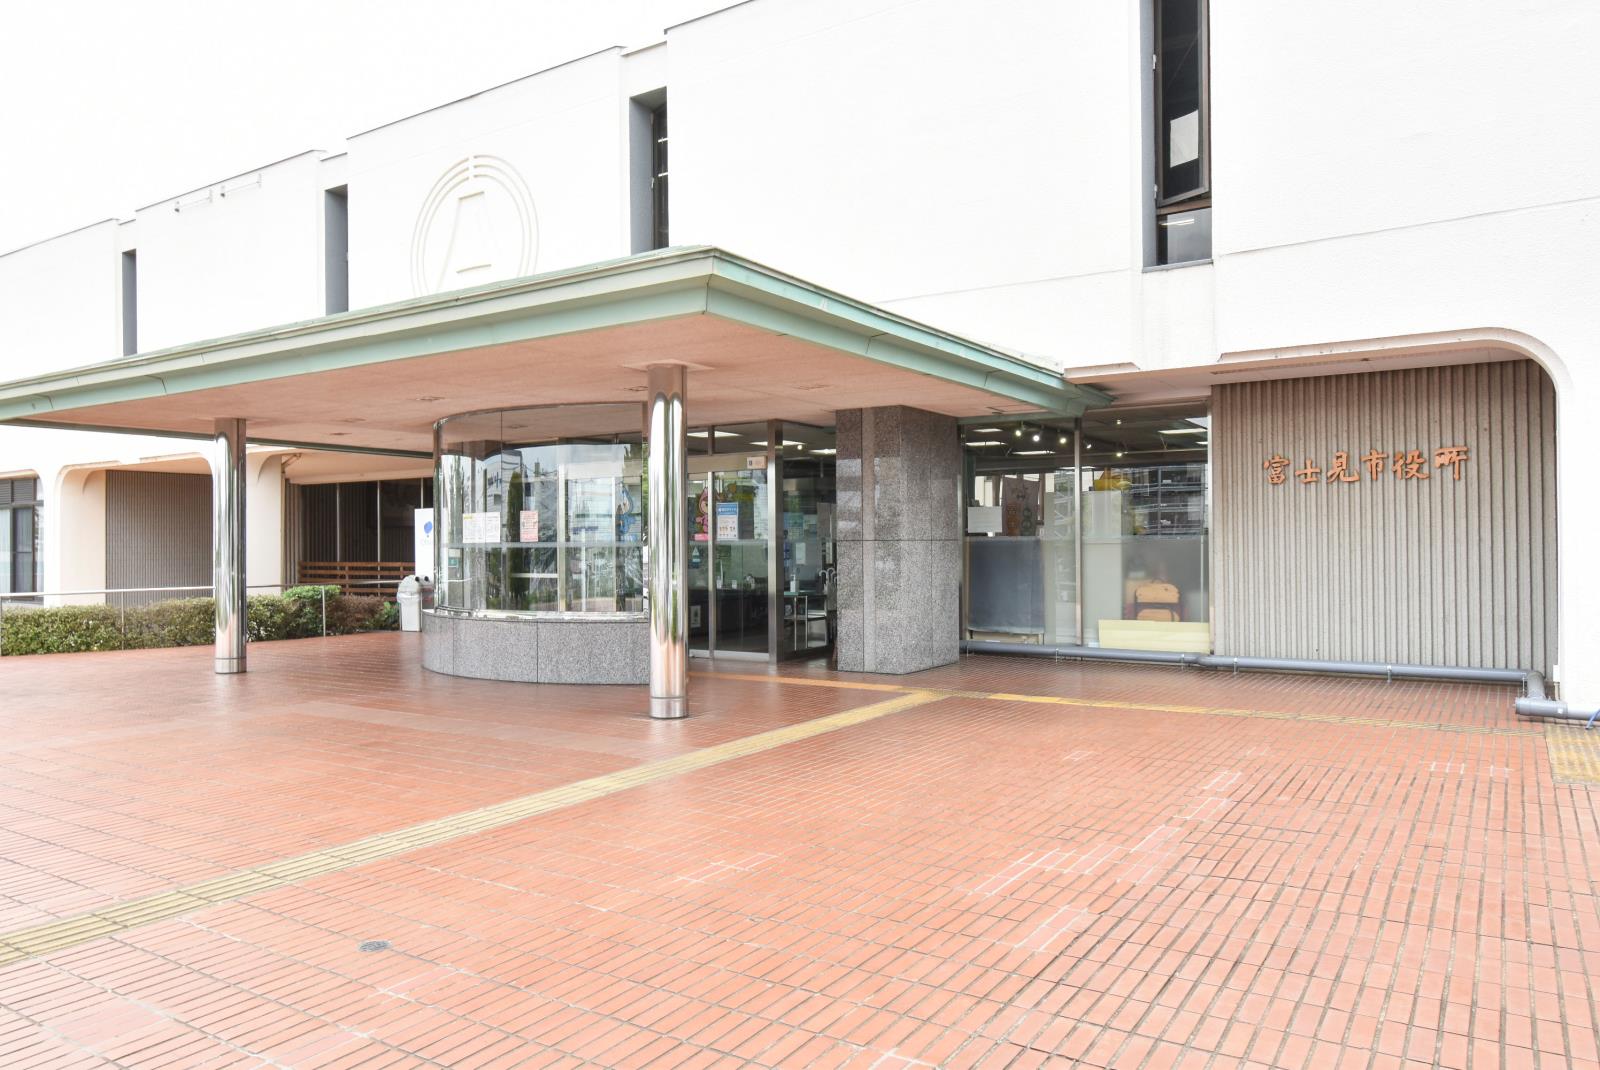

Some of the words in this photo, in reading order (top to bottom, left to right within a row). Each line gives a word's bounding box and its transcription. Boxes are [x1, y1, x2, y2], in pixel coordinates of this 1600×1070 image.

[1263, 445, 1468, 485] 富士見市役所
